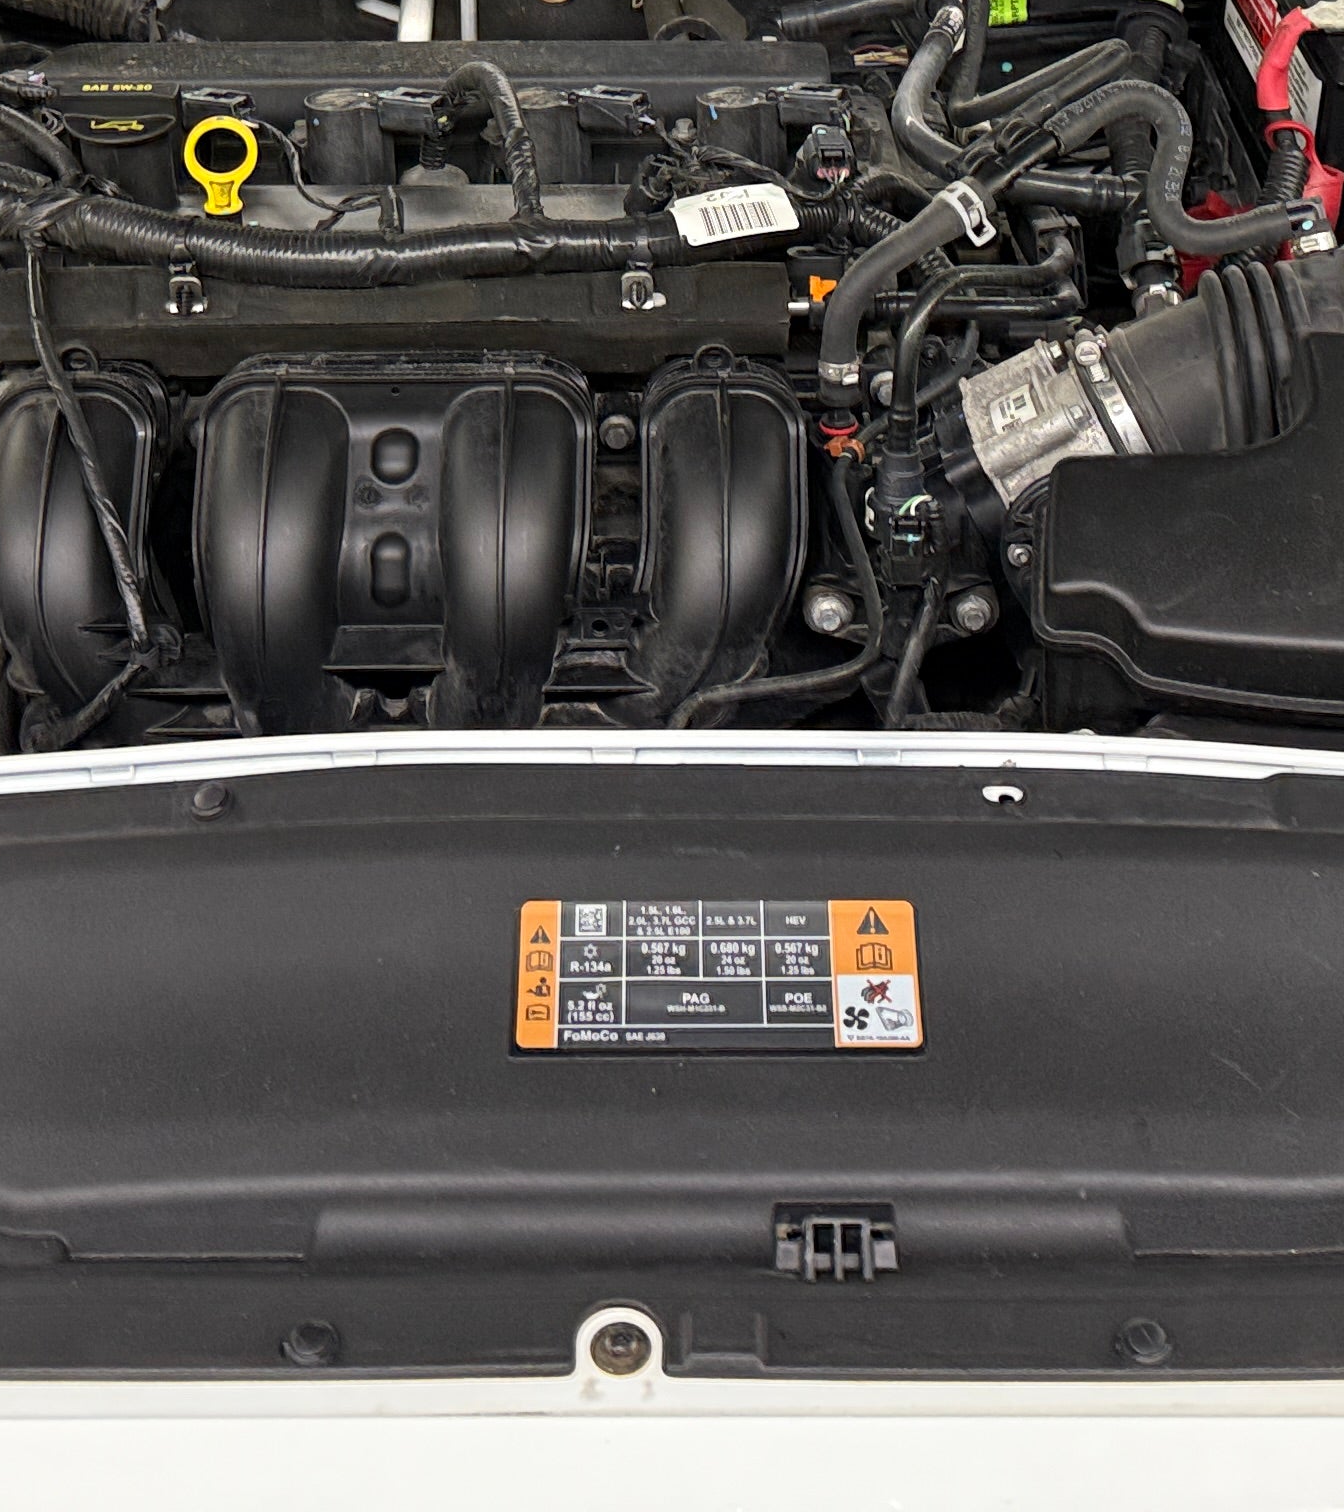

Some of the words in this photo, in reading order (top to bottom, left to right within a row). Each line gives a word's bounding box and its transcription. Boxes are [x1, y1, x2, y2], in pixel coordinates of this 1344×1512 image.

[82, 84, 109, 92] SAE
[785, 915, 807, 925] HEV
[641, 942, 670, 955] 0.567
[672, 942, 686, 956] kg
[741, 942, 756, 957] kg
[775, 942, 803, 954] 0.567
[805, 942, 819, 957] kg
[734, 956, 746, 965] oz
[785, 955, 797, 965] 20
[798, 956, 810, 965] oz
[569, 960, 612, 973] R-134a
[666, 966, 682, 975] lbs
[736, 966, 752, 976] lbs
[800, 966, 816, 976] lbs
[682, 992, 711, 1004] PAG
[784, 992, 813, 1004] POE
[587, 1000, 596, 1010] fl
[598, 1002, 614, 1011] oz
[567, 1010, 594, 1023] (155
[595, 1010, 615, 1023] cc)
[563, 1029, 619, 1042] FoMoCo
